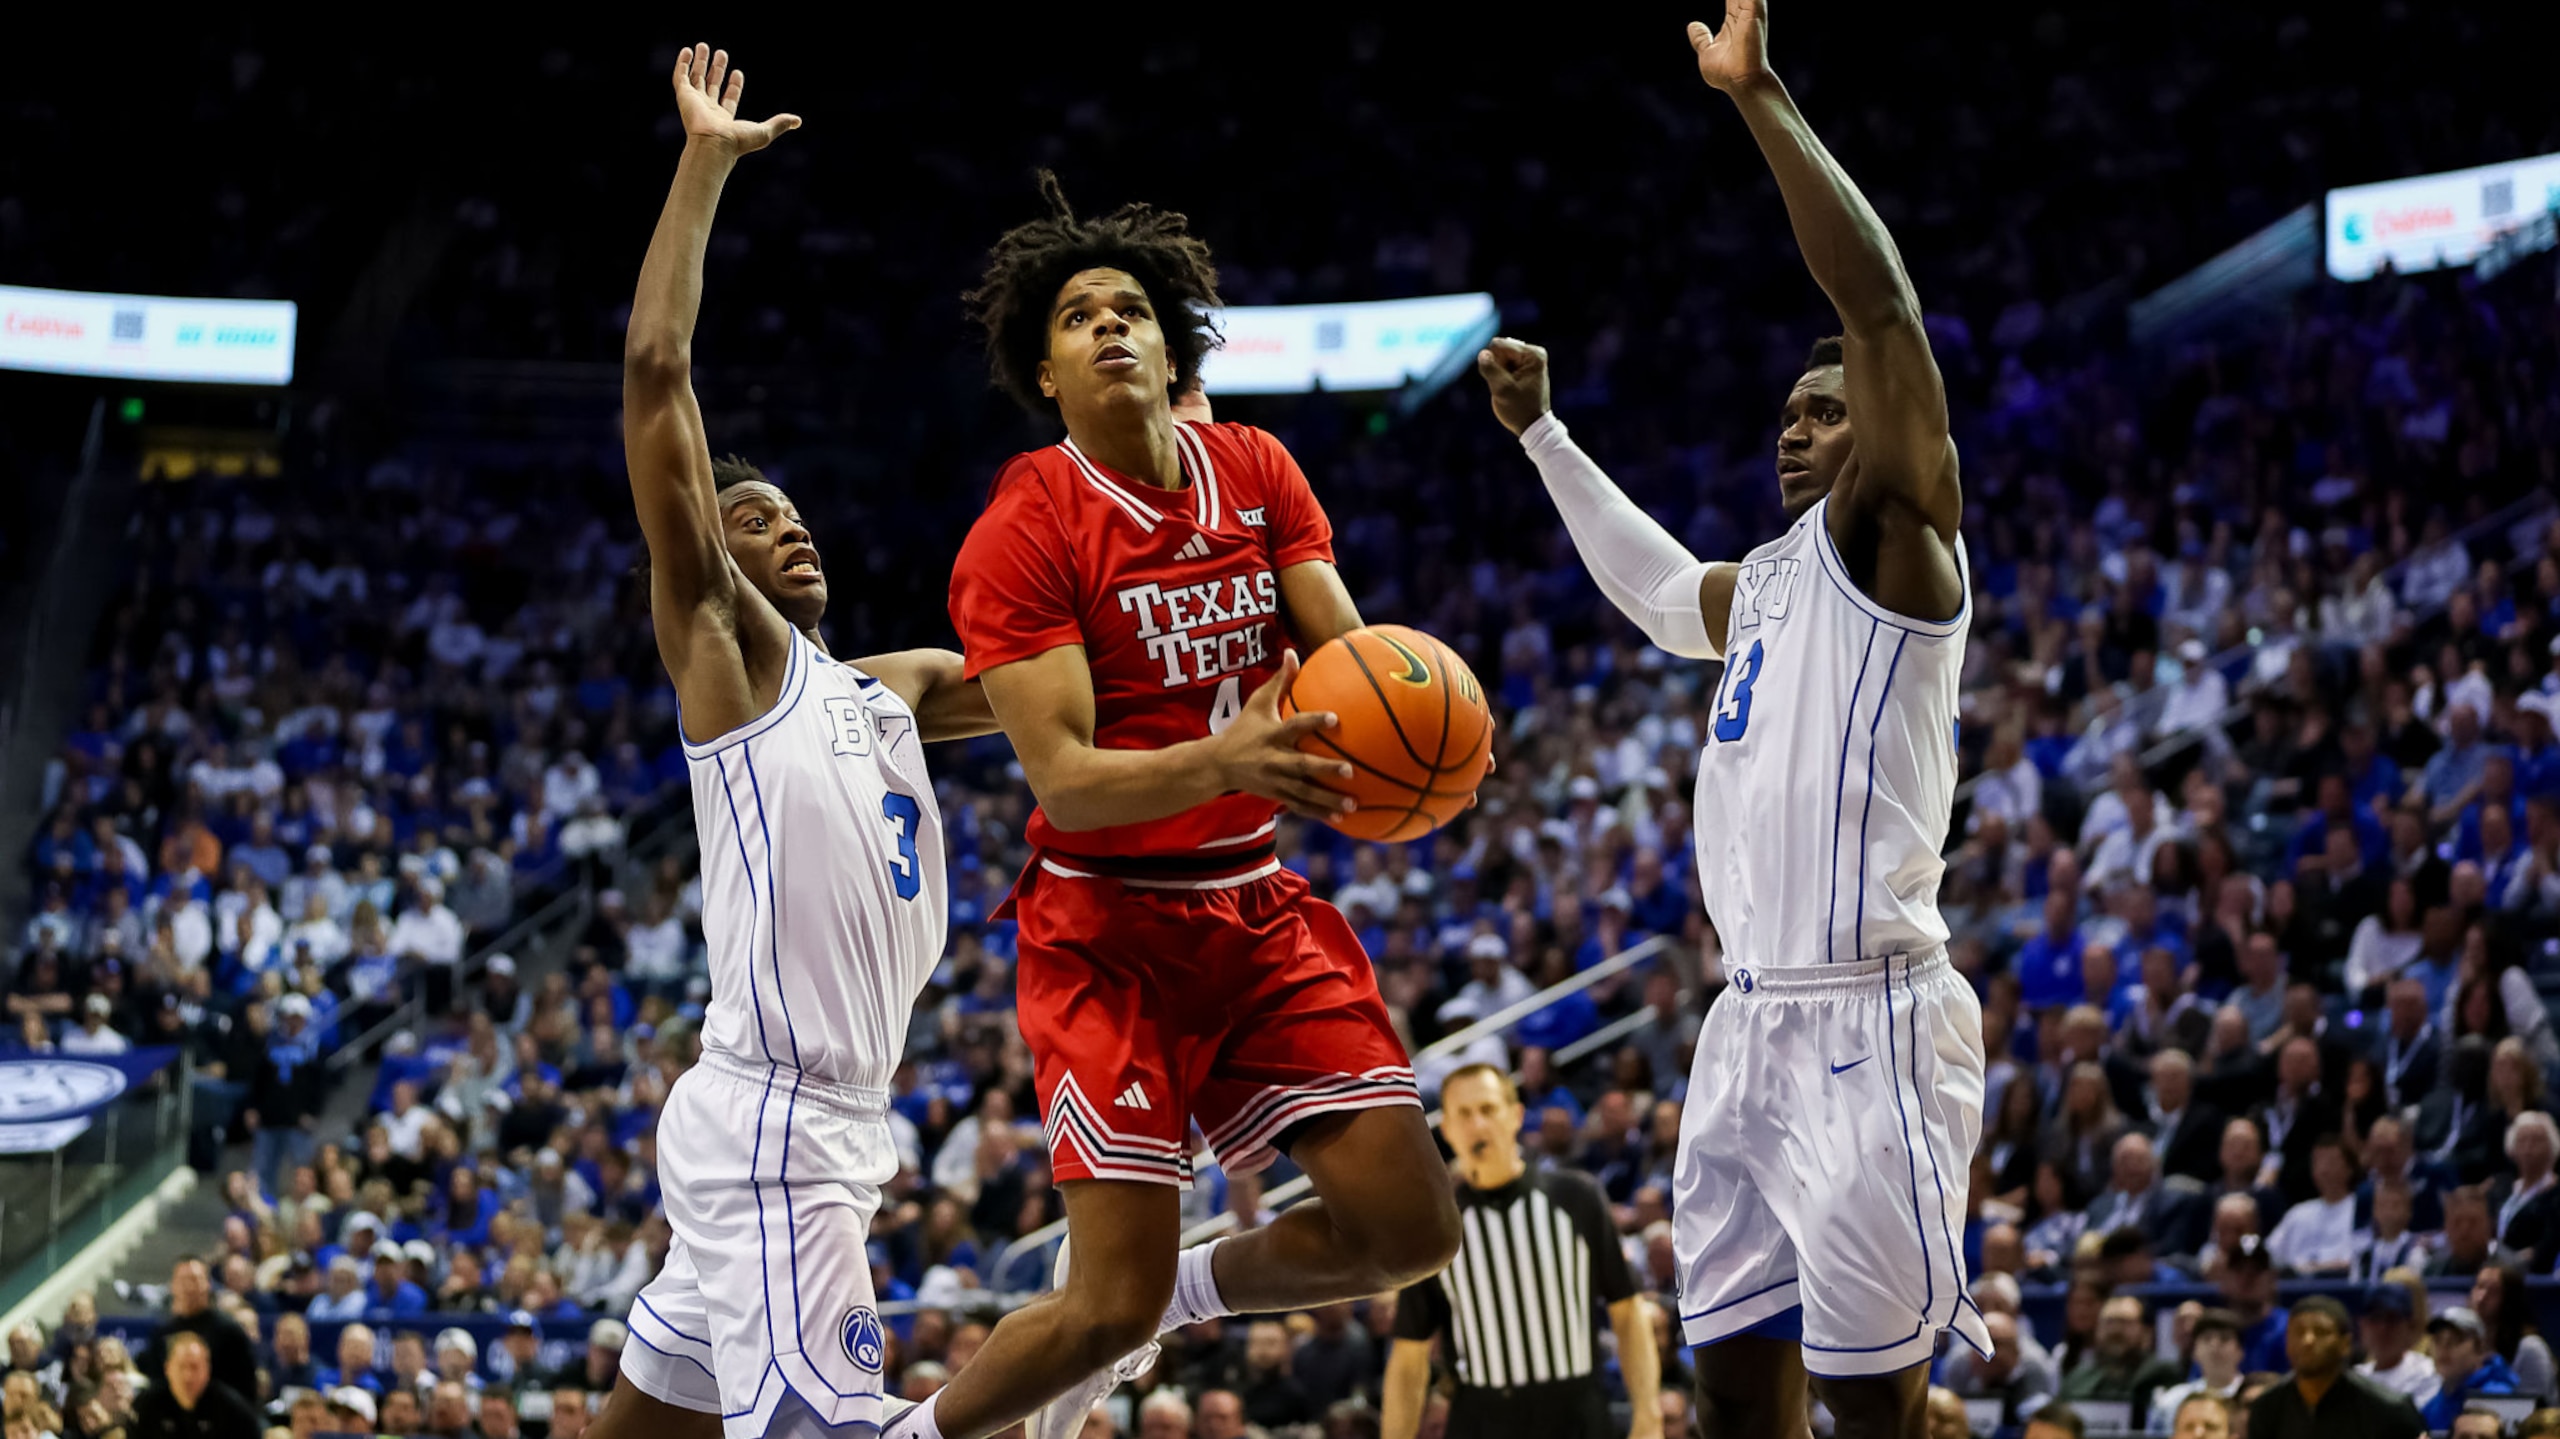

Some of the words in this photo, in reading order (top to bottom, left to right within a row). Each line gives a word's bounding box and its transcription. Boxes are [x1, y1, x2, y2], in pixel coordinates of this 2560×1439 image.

[1117, 570, 1277, 640] TEXAS
[1727, 558, 1801, 647] YU
[1146, 622, 1267, 688] TECH
[1208, 675, 1243, 736] 4
[881, 790, 922, 902] 3
